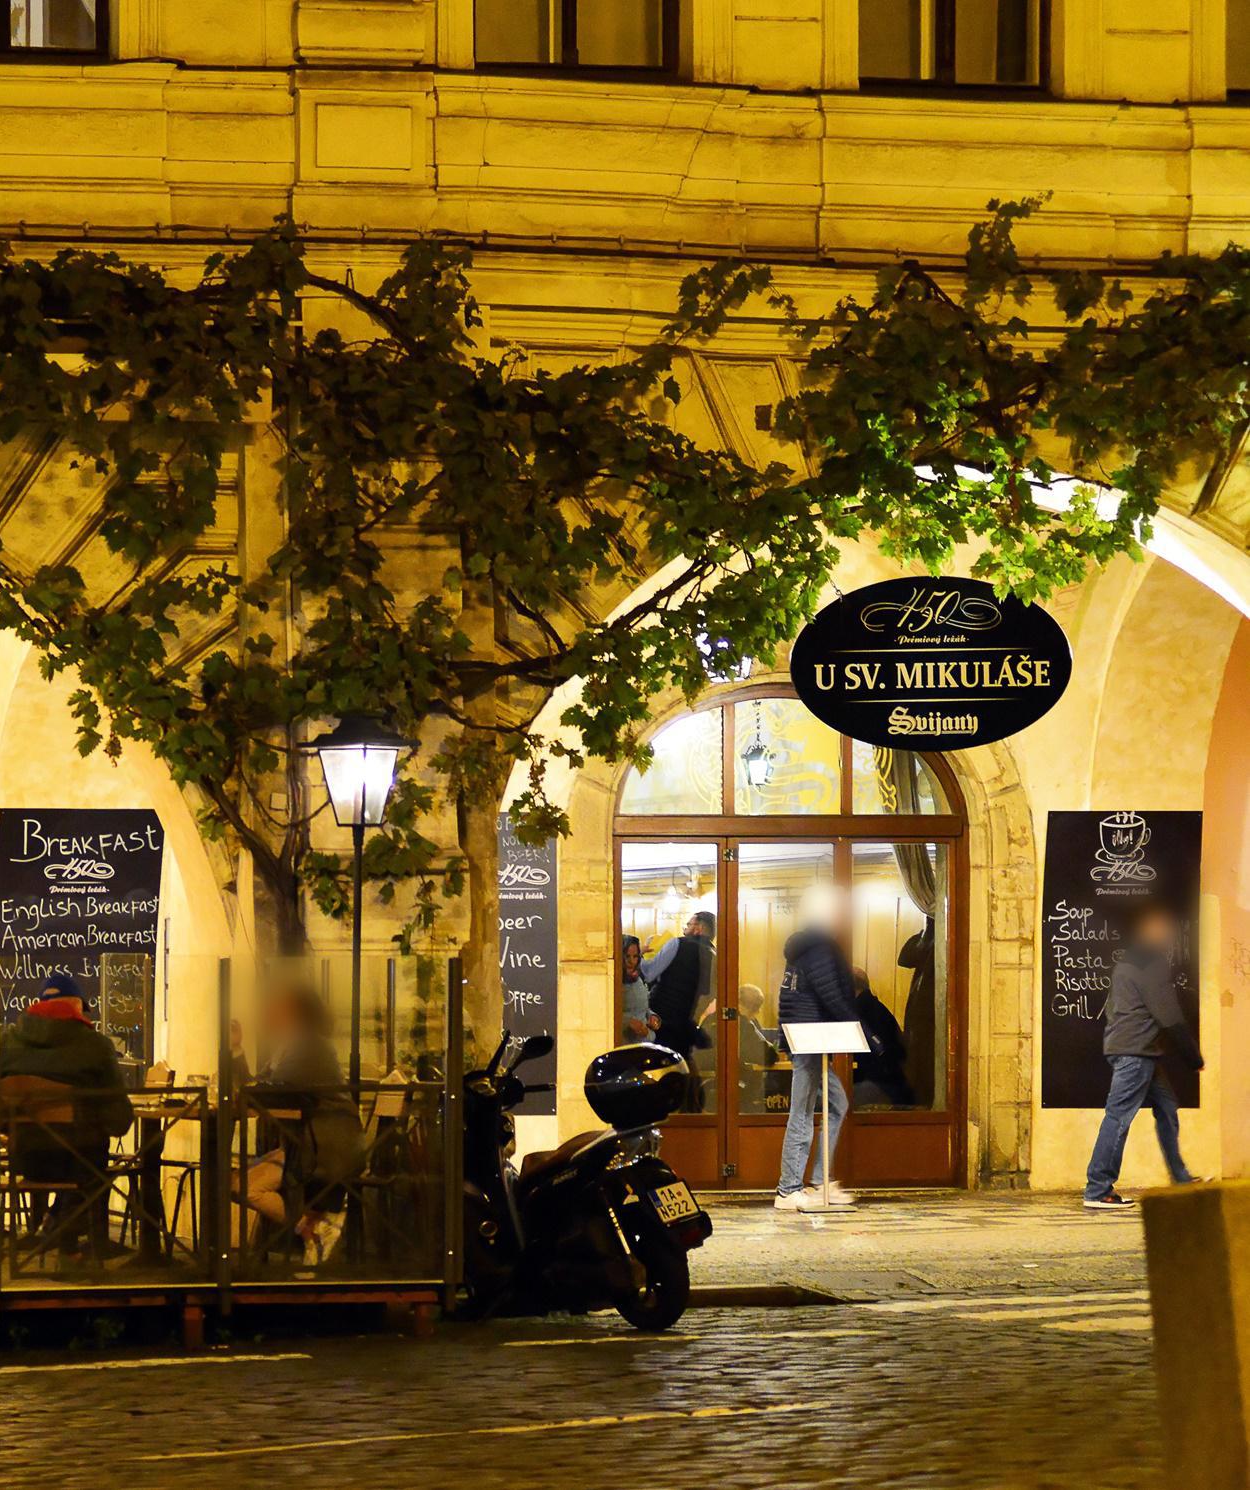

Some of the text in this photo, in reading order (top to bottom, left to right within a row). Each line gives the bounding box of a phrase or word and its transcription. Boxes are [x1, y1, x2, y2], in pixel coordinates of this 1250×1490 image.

[860, 587, 961, 633] 450
[814, 655, 1051, 691] U SV. MIKULÁŠE
[888, 706, 979, 737] Svijany
[1047, 899, 1094, 927] Soup
[1050, 919, 1121, 943] Salads
[1053, 944, 1111, 970] Pasta
[1054, 968, 1111, 992] Risotto
[1051, 993, 1094, 1019] Grill
